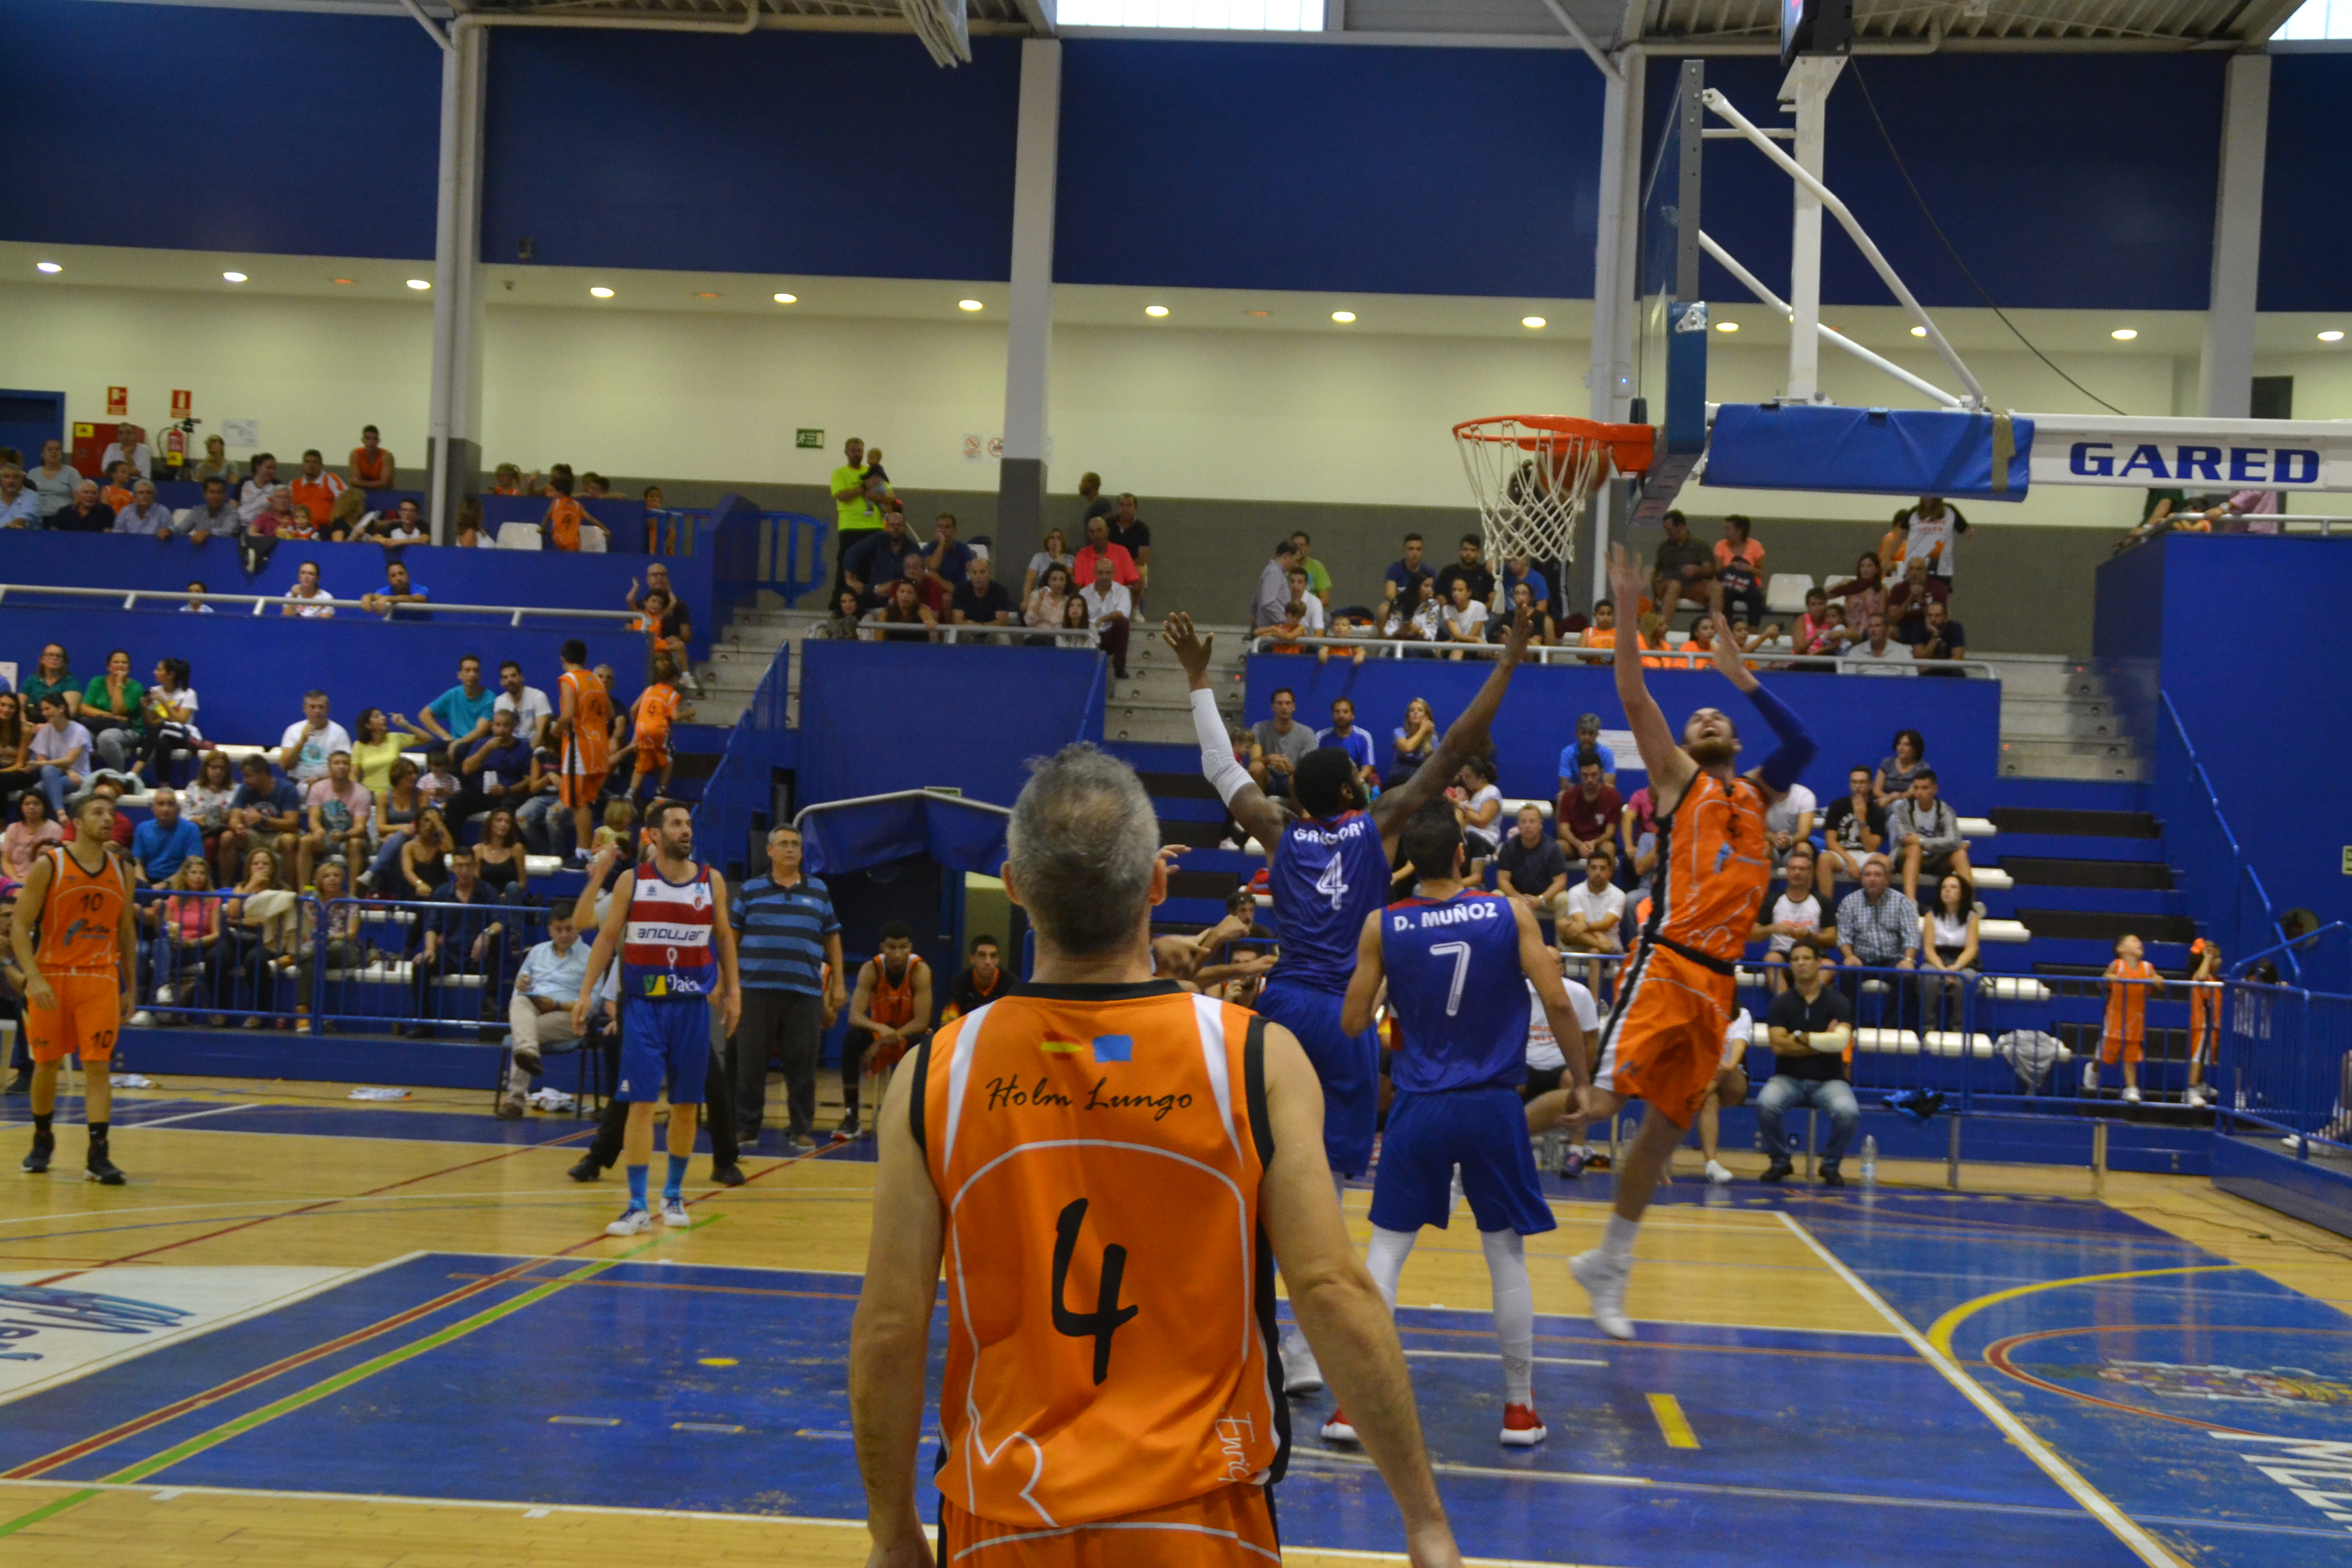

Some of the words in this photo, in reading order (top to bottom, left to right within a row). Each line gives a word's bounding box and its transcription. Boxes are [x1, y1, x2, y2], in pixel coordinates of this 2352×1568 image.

[2070, 442, 2319, 484] GARED
[81, 892, 104, 913] 10
[1316, 851, 1349, 910] 4
[1393, 915, 1416, 931] D.
[1421, 902, 1498, 928] MUÑOZ
[1430, 941, 1471, 1016] 7
[91, 1029, 113, 1049] 10
[985, 1073, 1073, 1111] Holm
[1084, 1077, 1192, 1122] Lungo
[1051, 1198, 1138, 1386] 4
